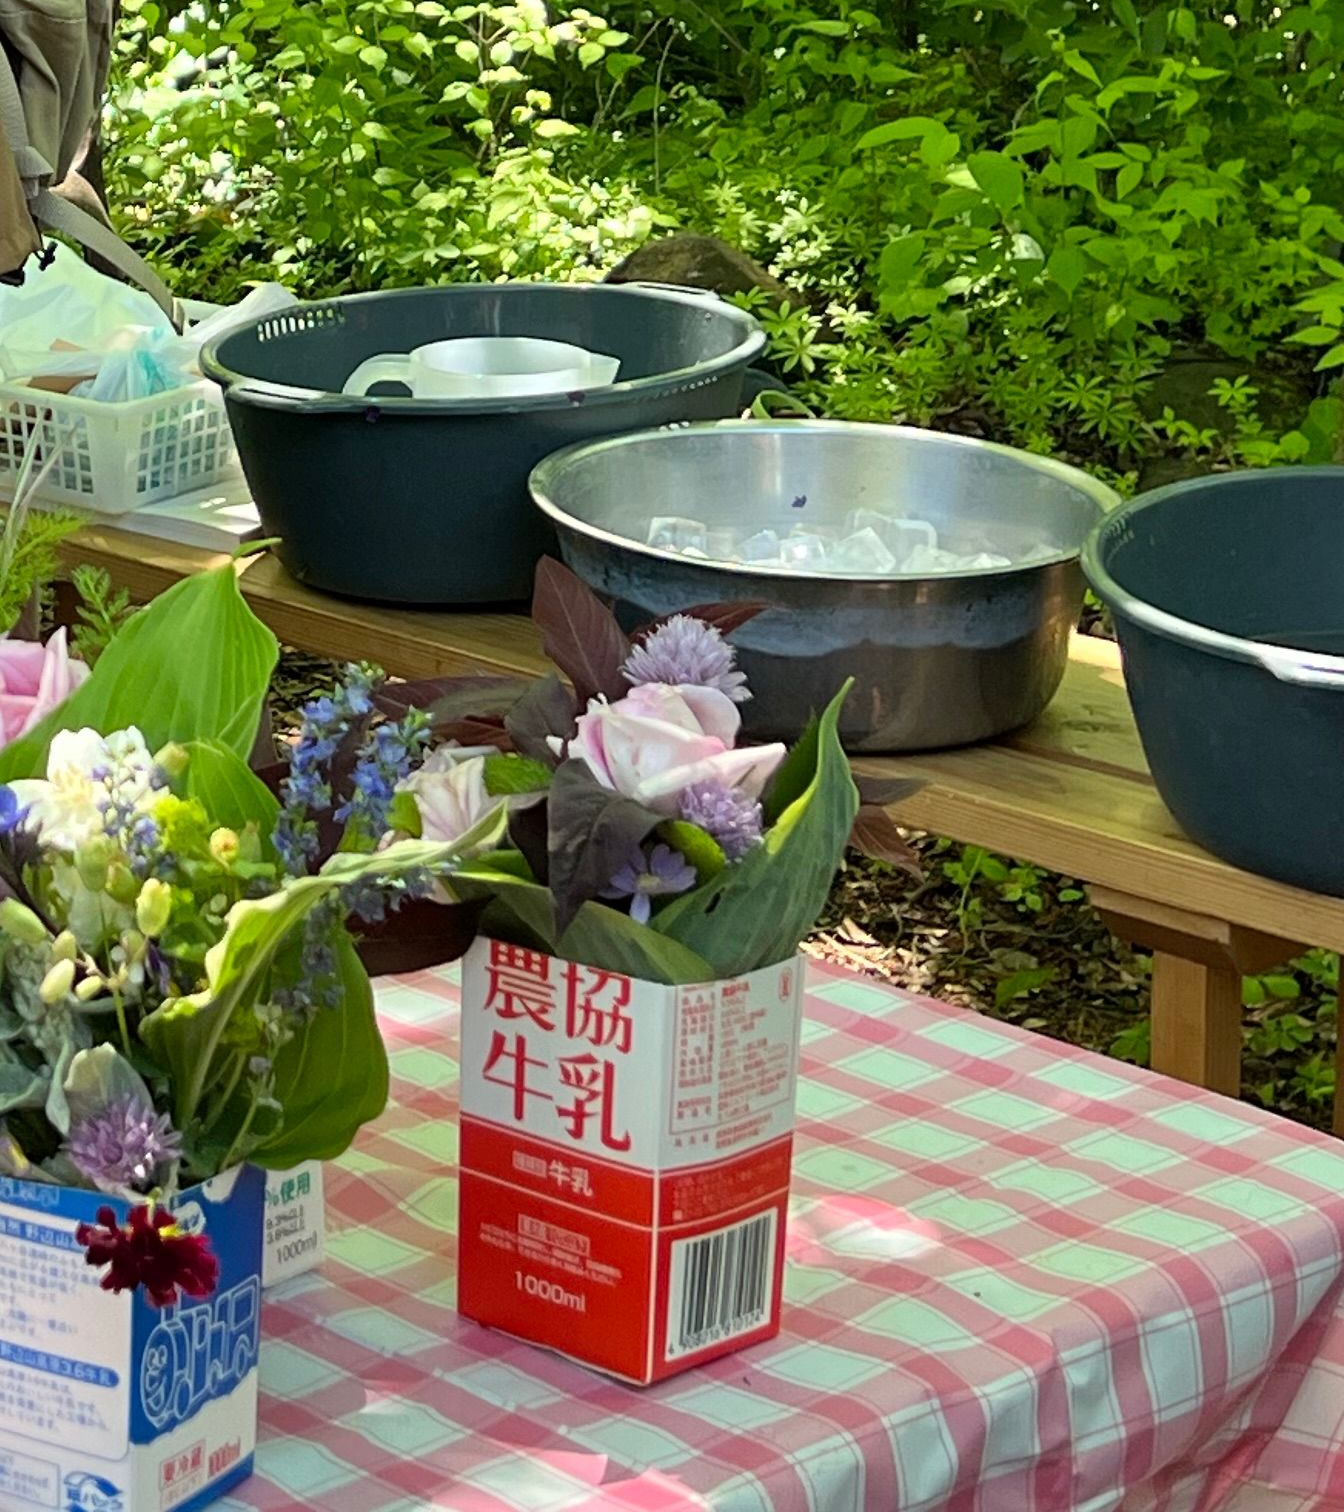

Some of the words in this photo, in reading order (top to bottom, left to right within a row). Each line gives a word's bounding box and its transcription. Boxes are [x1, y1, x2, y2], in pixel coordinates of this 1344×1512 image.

[483, 939, 634, 1055] 農協
[481, 1029, 632, 1152] 牛乳
[513, 1269, 587, 1314] 1000ml
